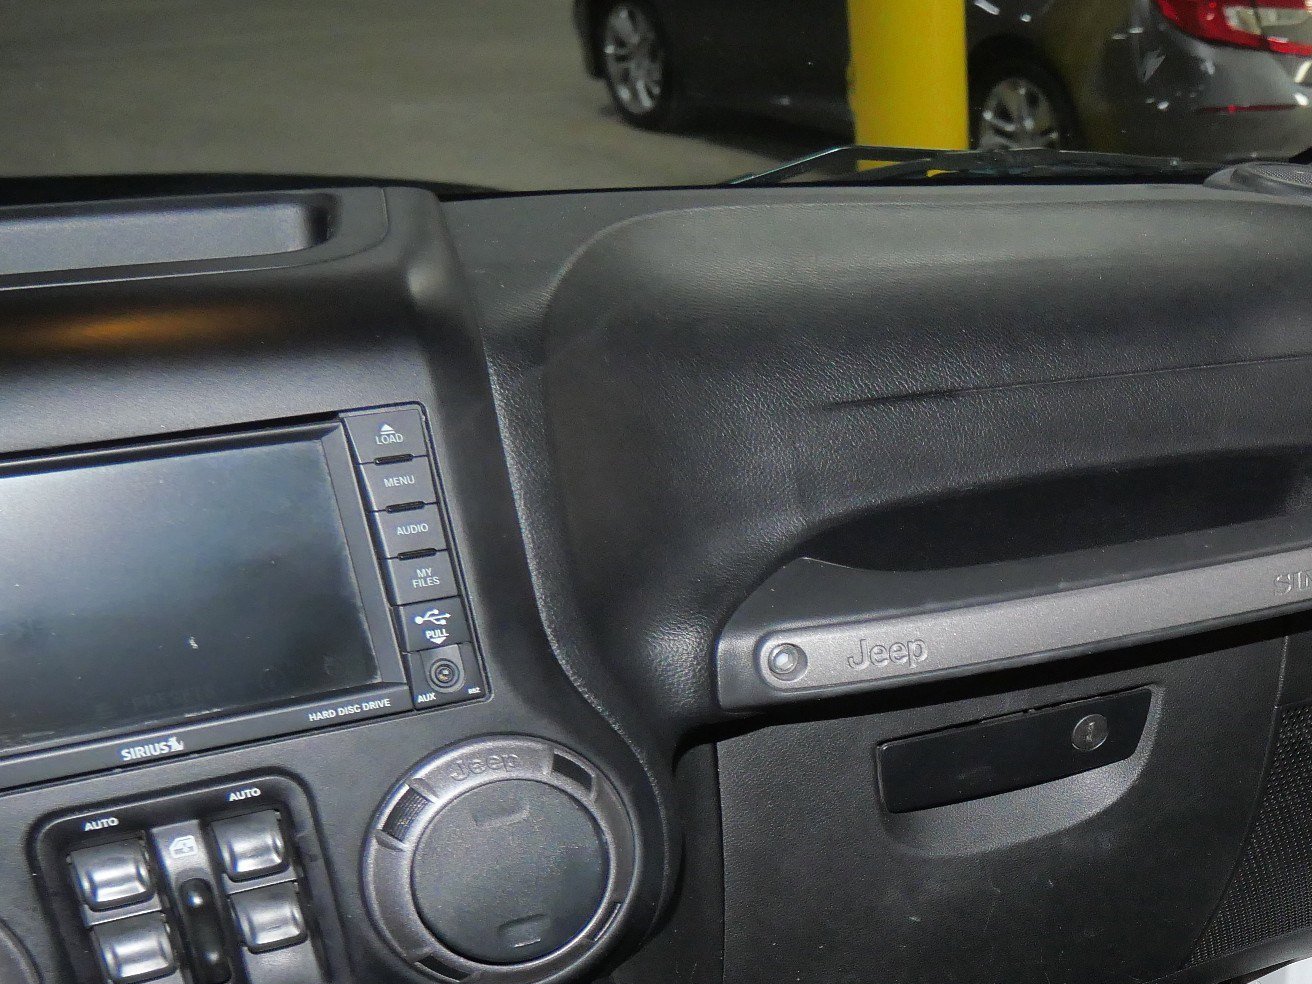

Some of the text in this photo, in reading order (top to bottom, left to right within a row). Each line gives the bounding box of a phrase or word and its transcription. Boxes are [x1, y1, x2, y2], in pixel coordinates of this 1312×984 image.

[375, 433, 403, 445] LOAD
[384, 475, 415, 487] MENU
[397, 523, 429, 535] AUDIO
[416, 568, 433, 578] MY
[413, 577, 440, 588] FILES
[425, 630, 450, 639] PULL
[847, 638, 929, 670] Jeep
[417, 693, 436, 704] AUX
[308, 698, 391, 721] HARD DISC DRIVE
[121, 741, 170, 761] SIRIUS
[450, 752, 520, 781] Jeep
[229, 788, 261, 801] AUTO
[84, 817, 119, 831] AUTO
